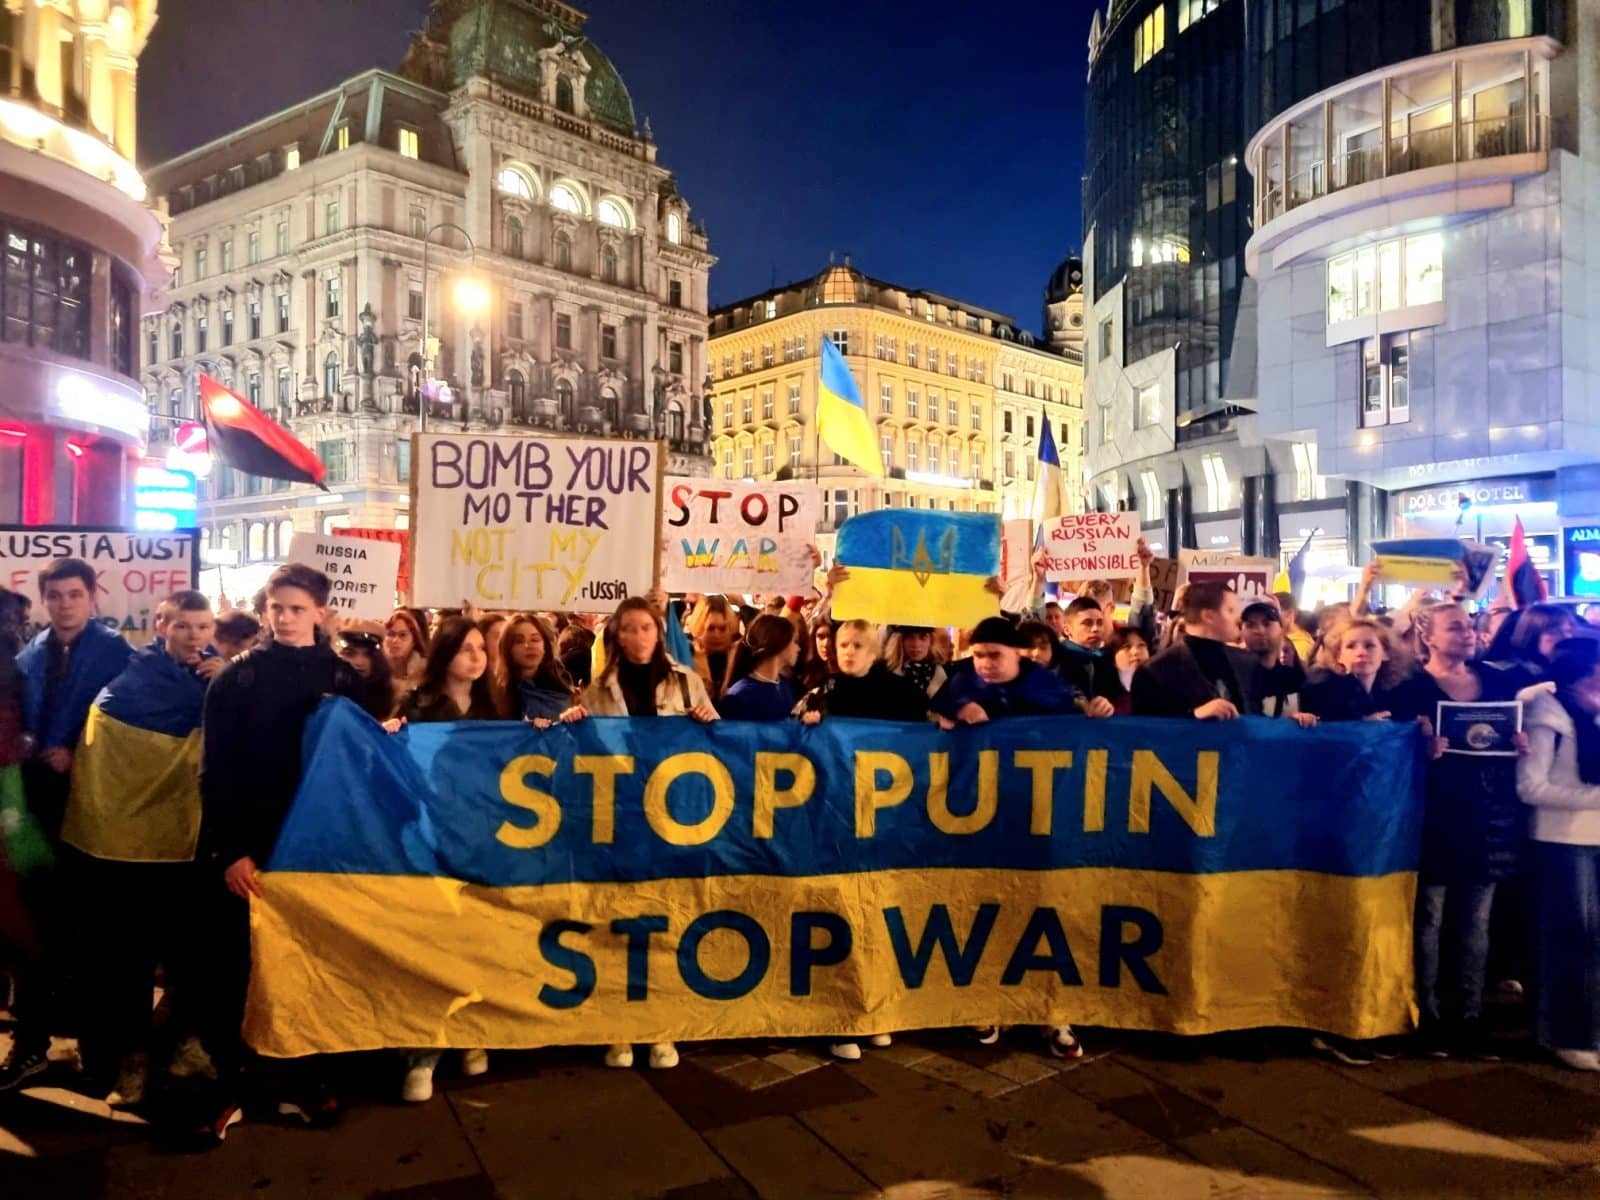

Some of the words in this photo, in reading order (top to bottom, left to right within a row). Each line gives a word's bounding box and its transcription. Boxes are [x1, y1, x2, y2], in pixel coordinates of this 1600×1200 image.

[432, 440, 553, 490] BOMB
[566, 446, 651, 494] YOUR
[463, 492, 609, 530] MOTHER
[668, 485, 799, 533] STOP
[1060, 513, 1121, 528] EVERY
[1051, 525, 1130, 541] RUSSIAN
[316, 544, 367, 560] RUSSIA
[451, 528, 515, 566] NOT
[550, 529, 606, 565] MY
[681, 537, 779, 574] WAR
[1083, 541, 1097, 553] IS
[325, 562, 338, 573] IS
[343, 564, 352, 574] A
[1045, 554, 1140, 571] RESPONSIBLE
[10, 570, 110, 595] FK
[124, 570, 189, 596] OFF
[333, 579, 377, 594] ORIST
[329, 596, 356, 609] ATE
[496, 751, 816, 848] STOP
[855, 749, 1219, 838] PUTIN
[538, 910, 853, 1010] STOP
[882, 903, 1168, 995] WAR
